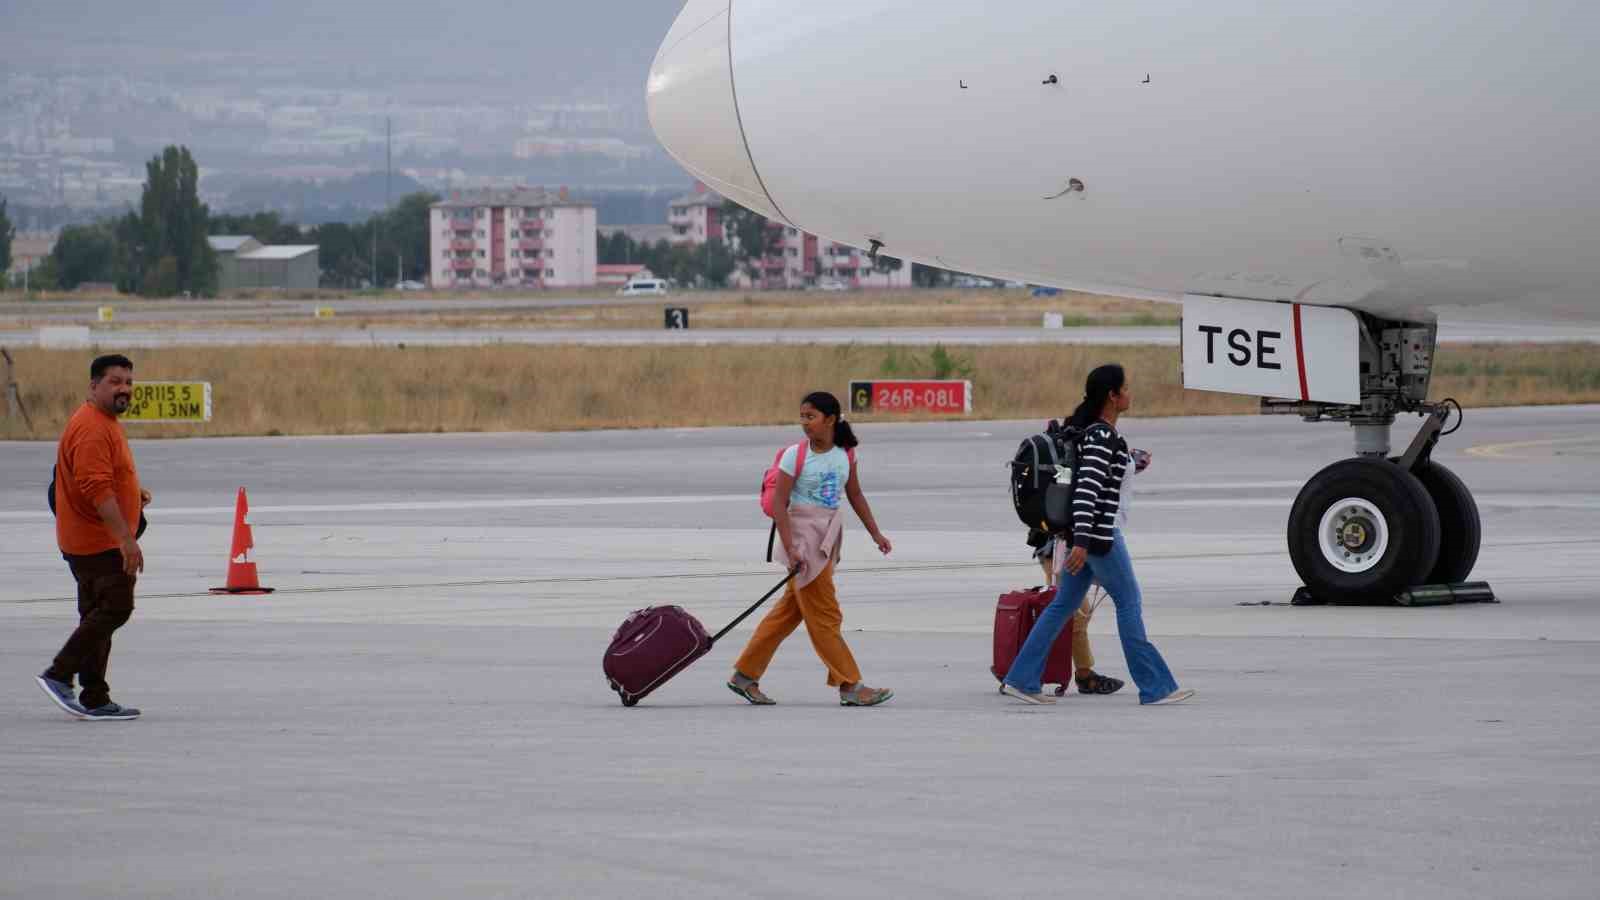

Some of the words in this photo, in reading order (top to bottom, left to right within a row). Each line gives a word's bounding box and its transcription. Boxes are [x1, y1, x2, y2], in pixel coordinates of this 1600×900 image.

[672, 310, 683, 330] 3
[1198, 324, 1281, 370] TSE
[133, 385, 191, 401] OR115.5
[856, 389, 867, 407] G
[879, 389, 960, 408] 26R-08L
